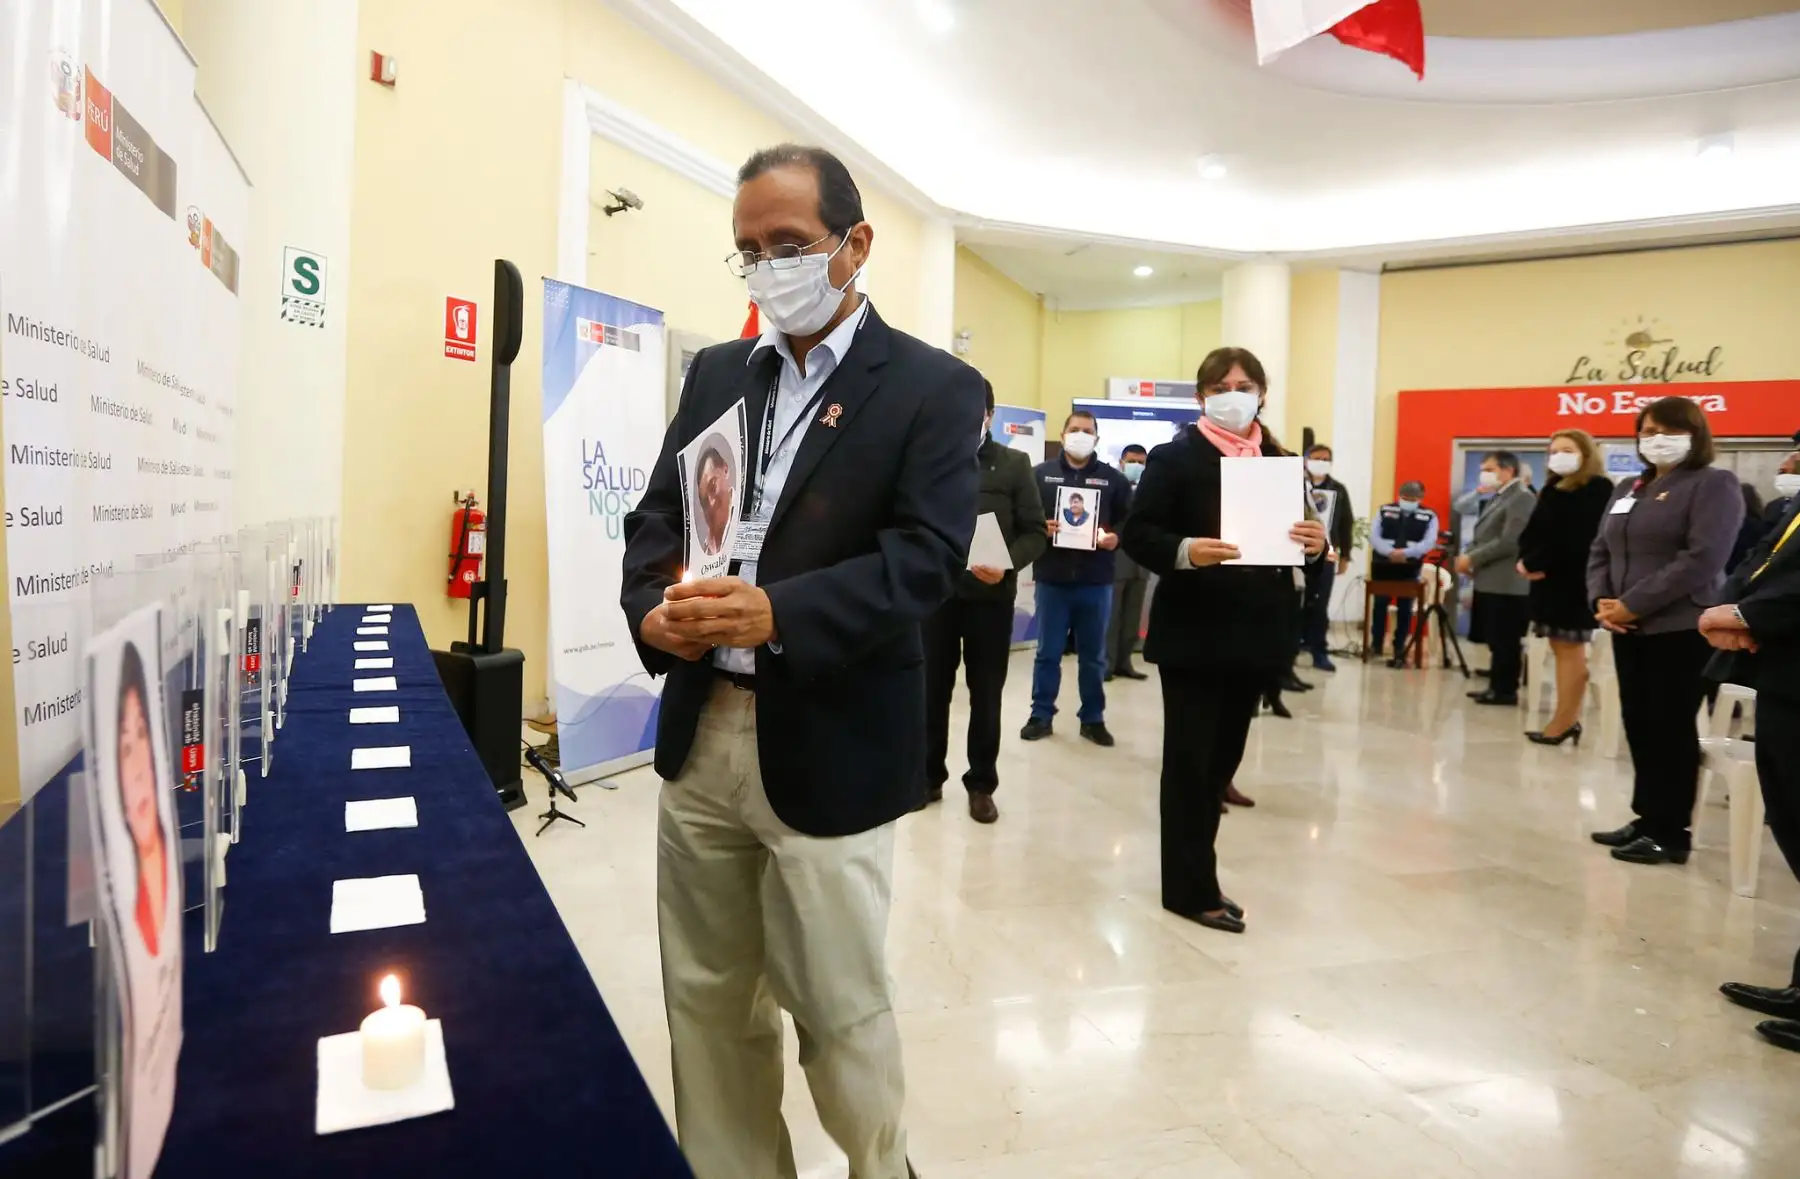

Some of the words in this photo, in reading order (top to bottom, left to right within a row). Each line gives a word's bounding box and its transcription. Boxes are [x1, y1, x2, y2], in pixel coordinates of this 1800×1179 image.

[116, 124, 144, 163] Ministerio
[116, 144, 124, 162] de
[124, 151, 140, 176] Salud
[291, 256, 320, 295] S
[8, 313, 79, 350] Ministerio
[87, 339, 110, 363] Salud
[1565, 356, 1608, 384] La
[1617, 346, 1725, 382] Salud
[0, 380, 9, 395] e
[16, 377, 58, 402] Salud
[91, 394, 128, 419] Ministerio
[1556, 392, 1606, 415] No
[11, 444, 80, 467] Ministerio
[88, 451, 111, 469] Salud
[582, 439, 607, 465] LA
[582, 464, 645, 491] SALUD
[93, 505, 129, 522] Ministerio
[589, 491, 631, 515] NOS
[5, 512, 13, 527] e
[20, 505, 63, 527] Salud
[606, 515, 625, 539] U
[16, 571, 79, 596] Ministeri
[12, 648, 21, 663] e
[27, 632, 68, 661] Salud
